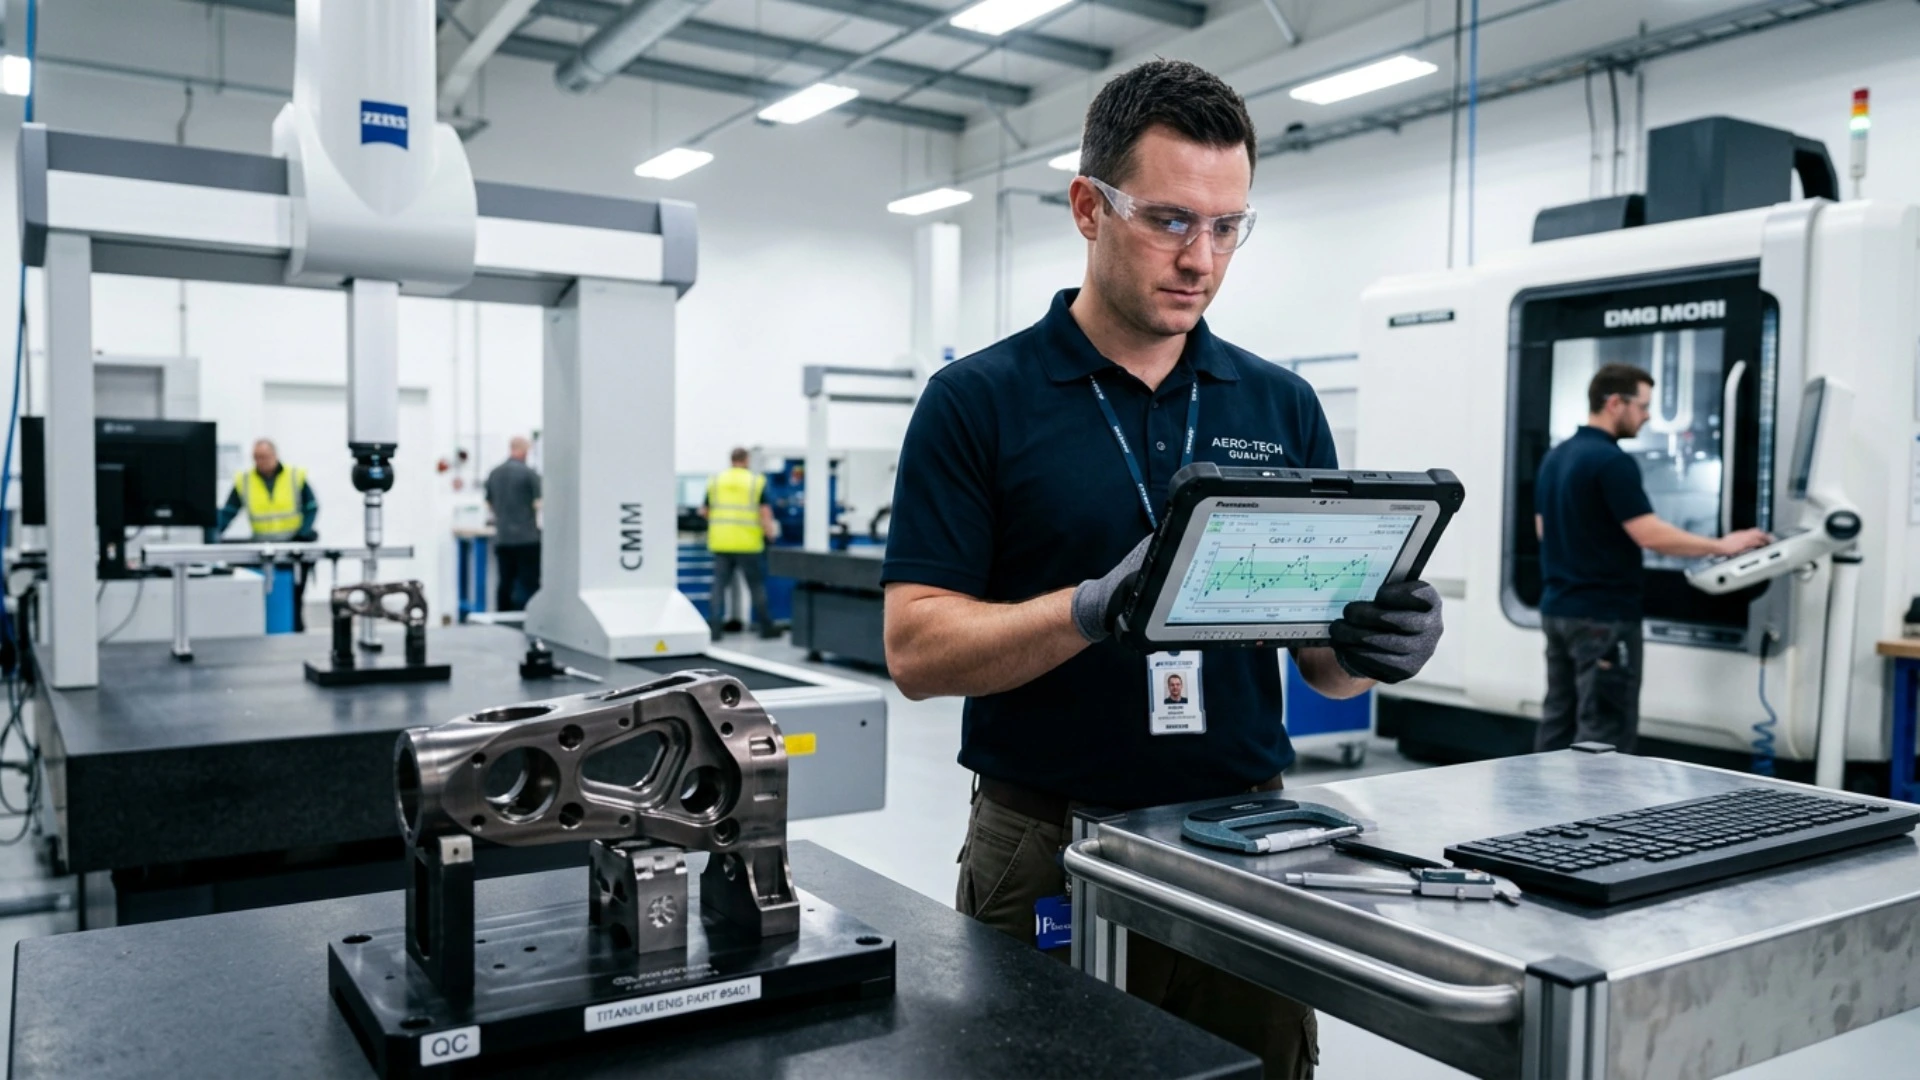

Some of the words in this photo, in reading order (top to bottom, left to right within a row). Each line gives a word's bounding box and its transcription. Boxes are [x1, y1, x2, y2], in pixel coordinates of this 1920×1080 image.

[1604, 305, 1659, 328] DMG
[1660, 299, 1726, 323] MORI
[1211, 437, 1283, 455] AERO-TECH
[620, 503, 643, 571] CMM
[596, 1002, 655, 1023] TITANIUM
[686, 989, 718, 1006] PART
[431, 1033, 469, 1057] QC
